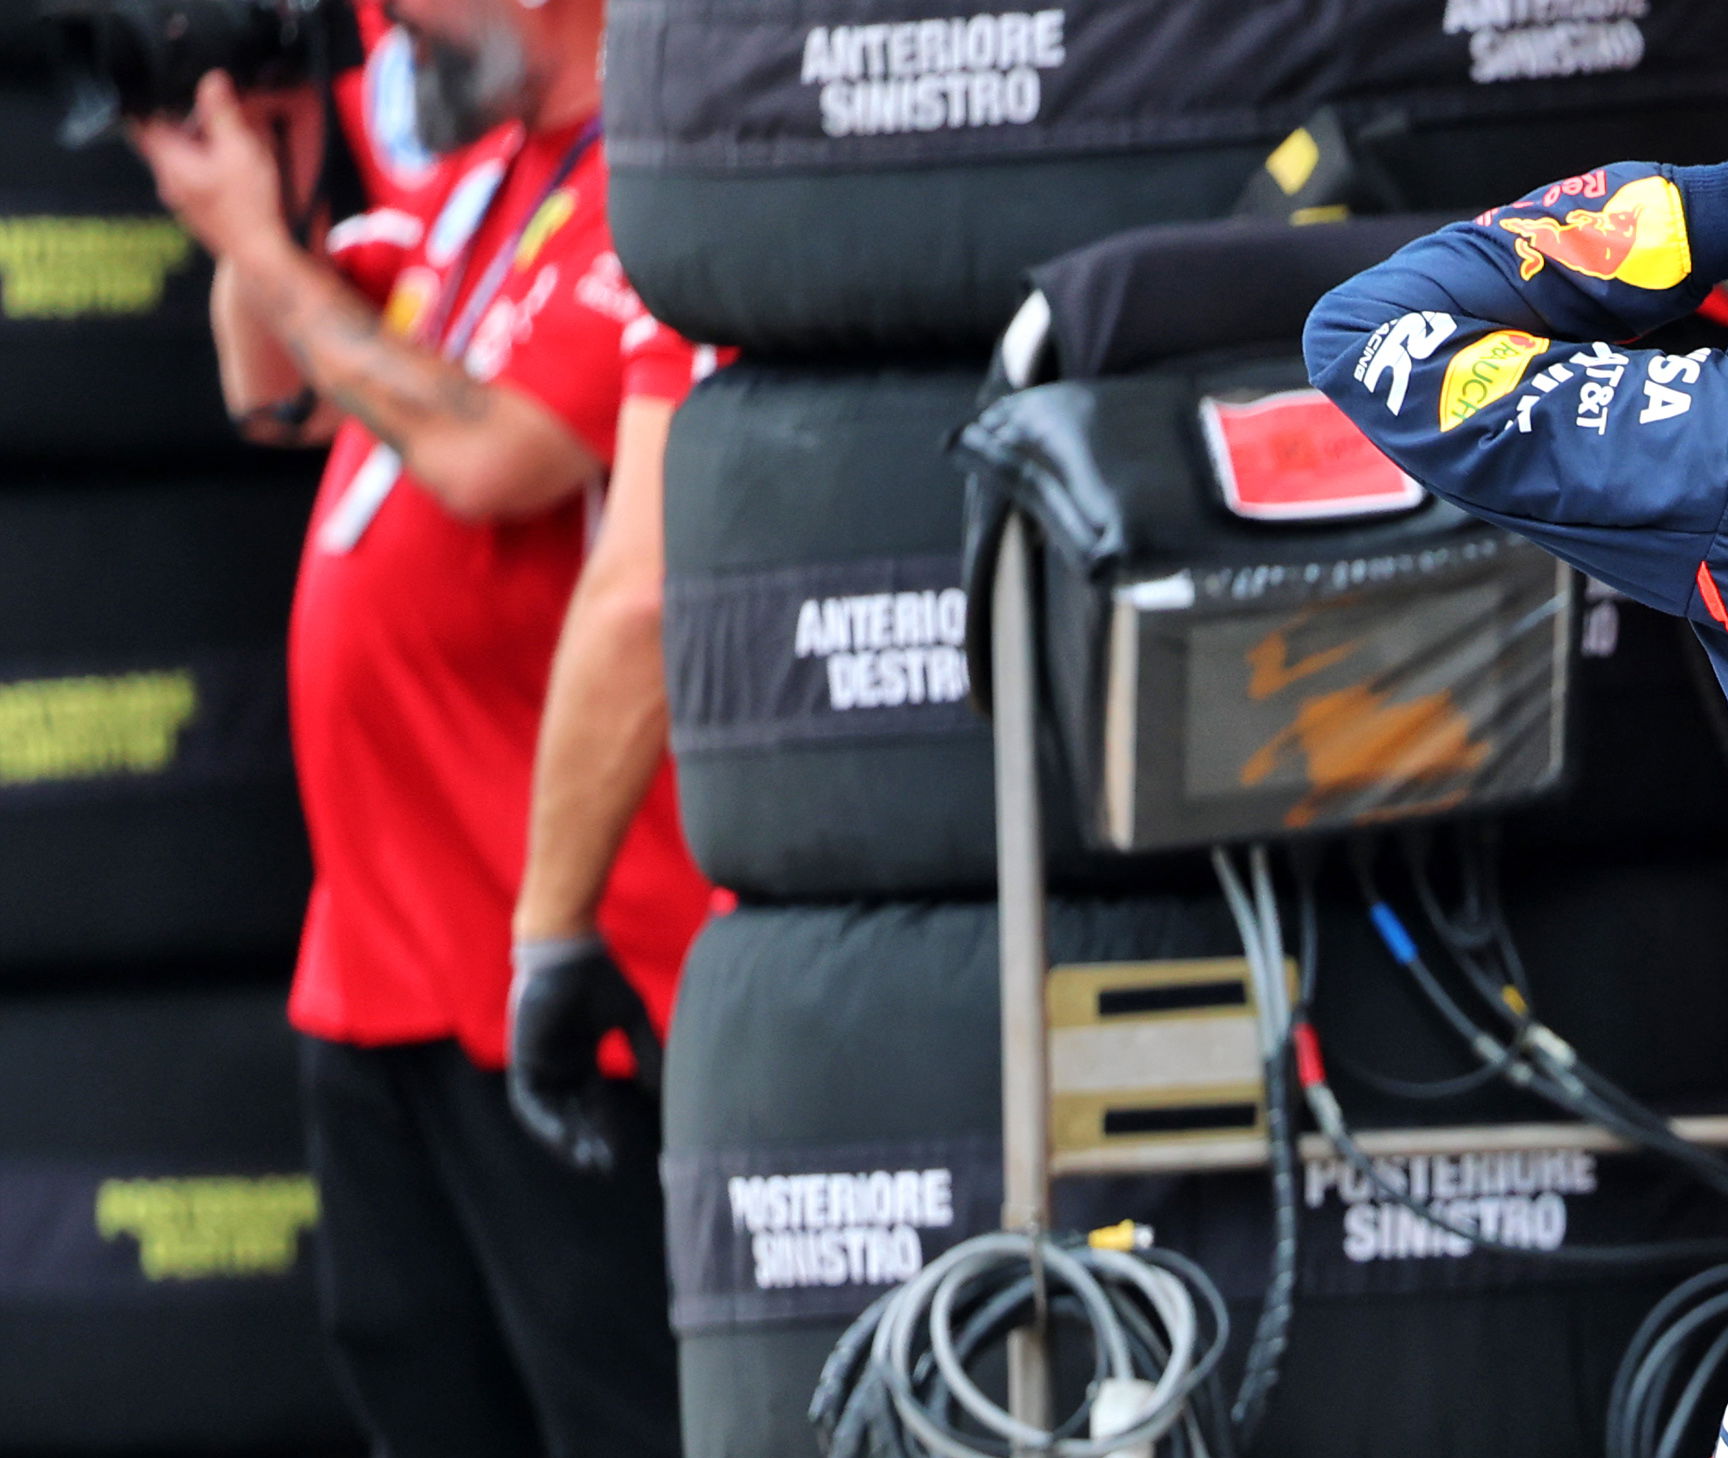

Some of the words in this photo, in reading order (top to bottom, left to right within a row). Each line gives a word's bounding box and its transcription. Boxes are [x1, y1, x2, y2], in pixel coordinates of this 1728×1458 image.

[800, 9, 1066, 84] ANTERIORE
[819, 67, 1041, 137] SINISTRO
[1353, 316, 1403, 382] ACING
[827, 645, 971, 711] DESTR
